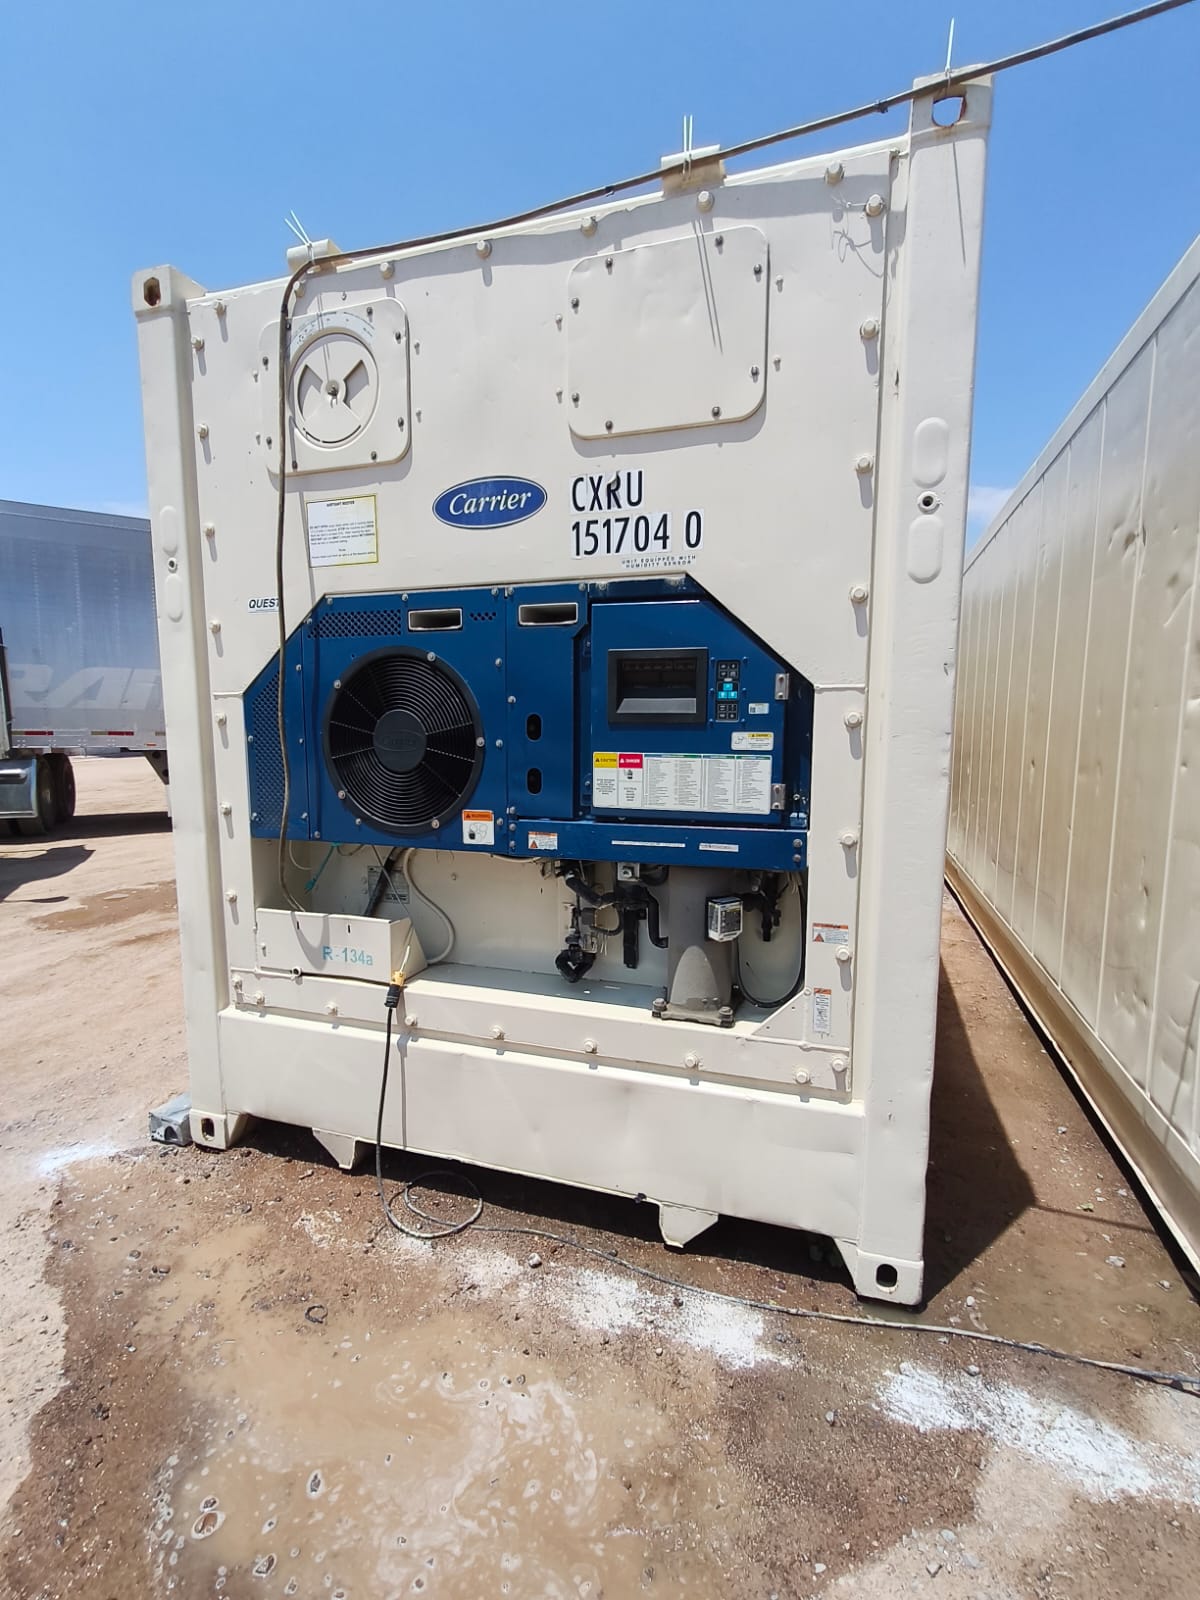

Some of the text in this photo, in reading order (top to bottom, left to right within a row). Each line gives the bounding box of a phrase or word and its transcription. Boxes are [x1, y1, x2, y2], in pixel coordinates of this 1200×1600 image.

[448, 490, 532, 515] Carrier
[571, 470, 643, 511] CXRU
[571, 511, 702, 556] 151704 0
[322, 945, 374, 966] R-134a
